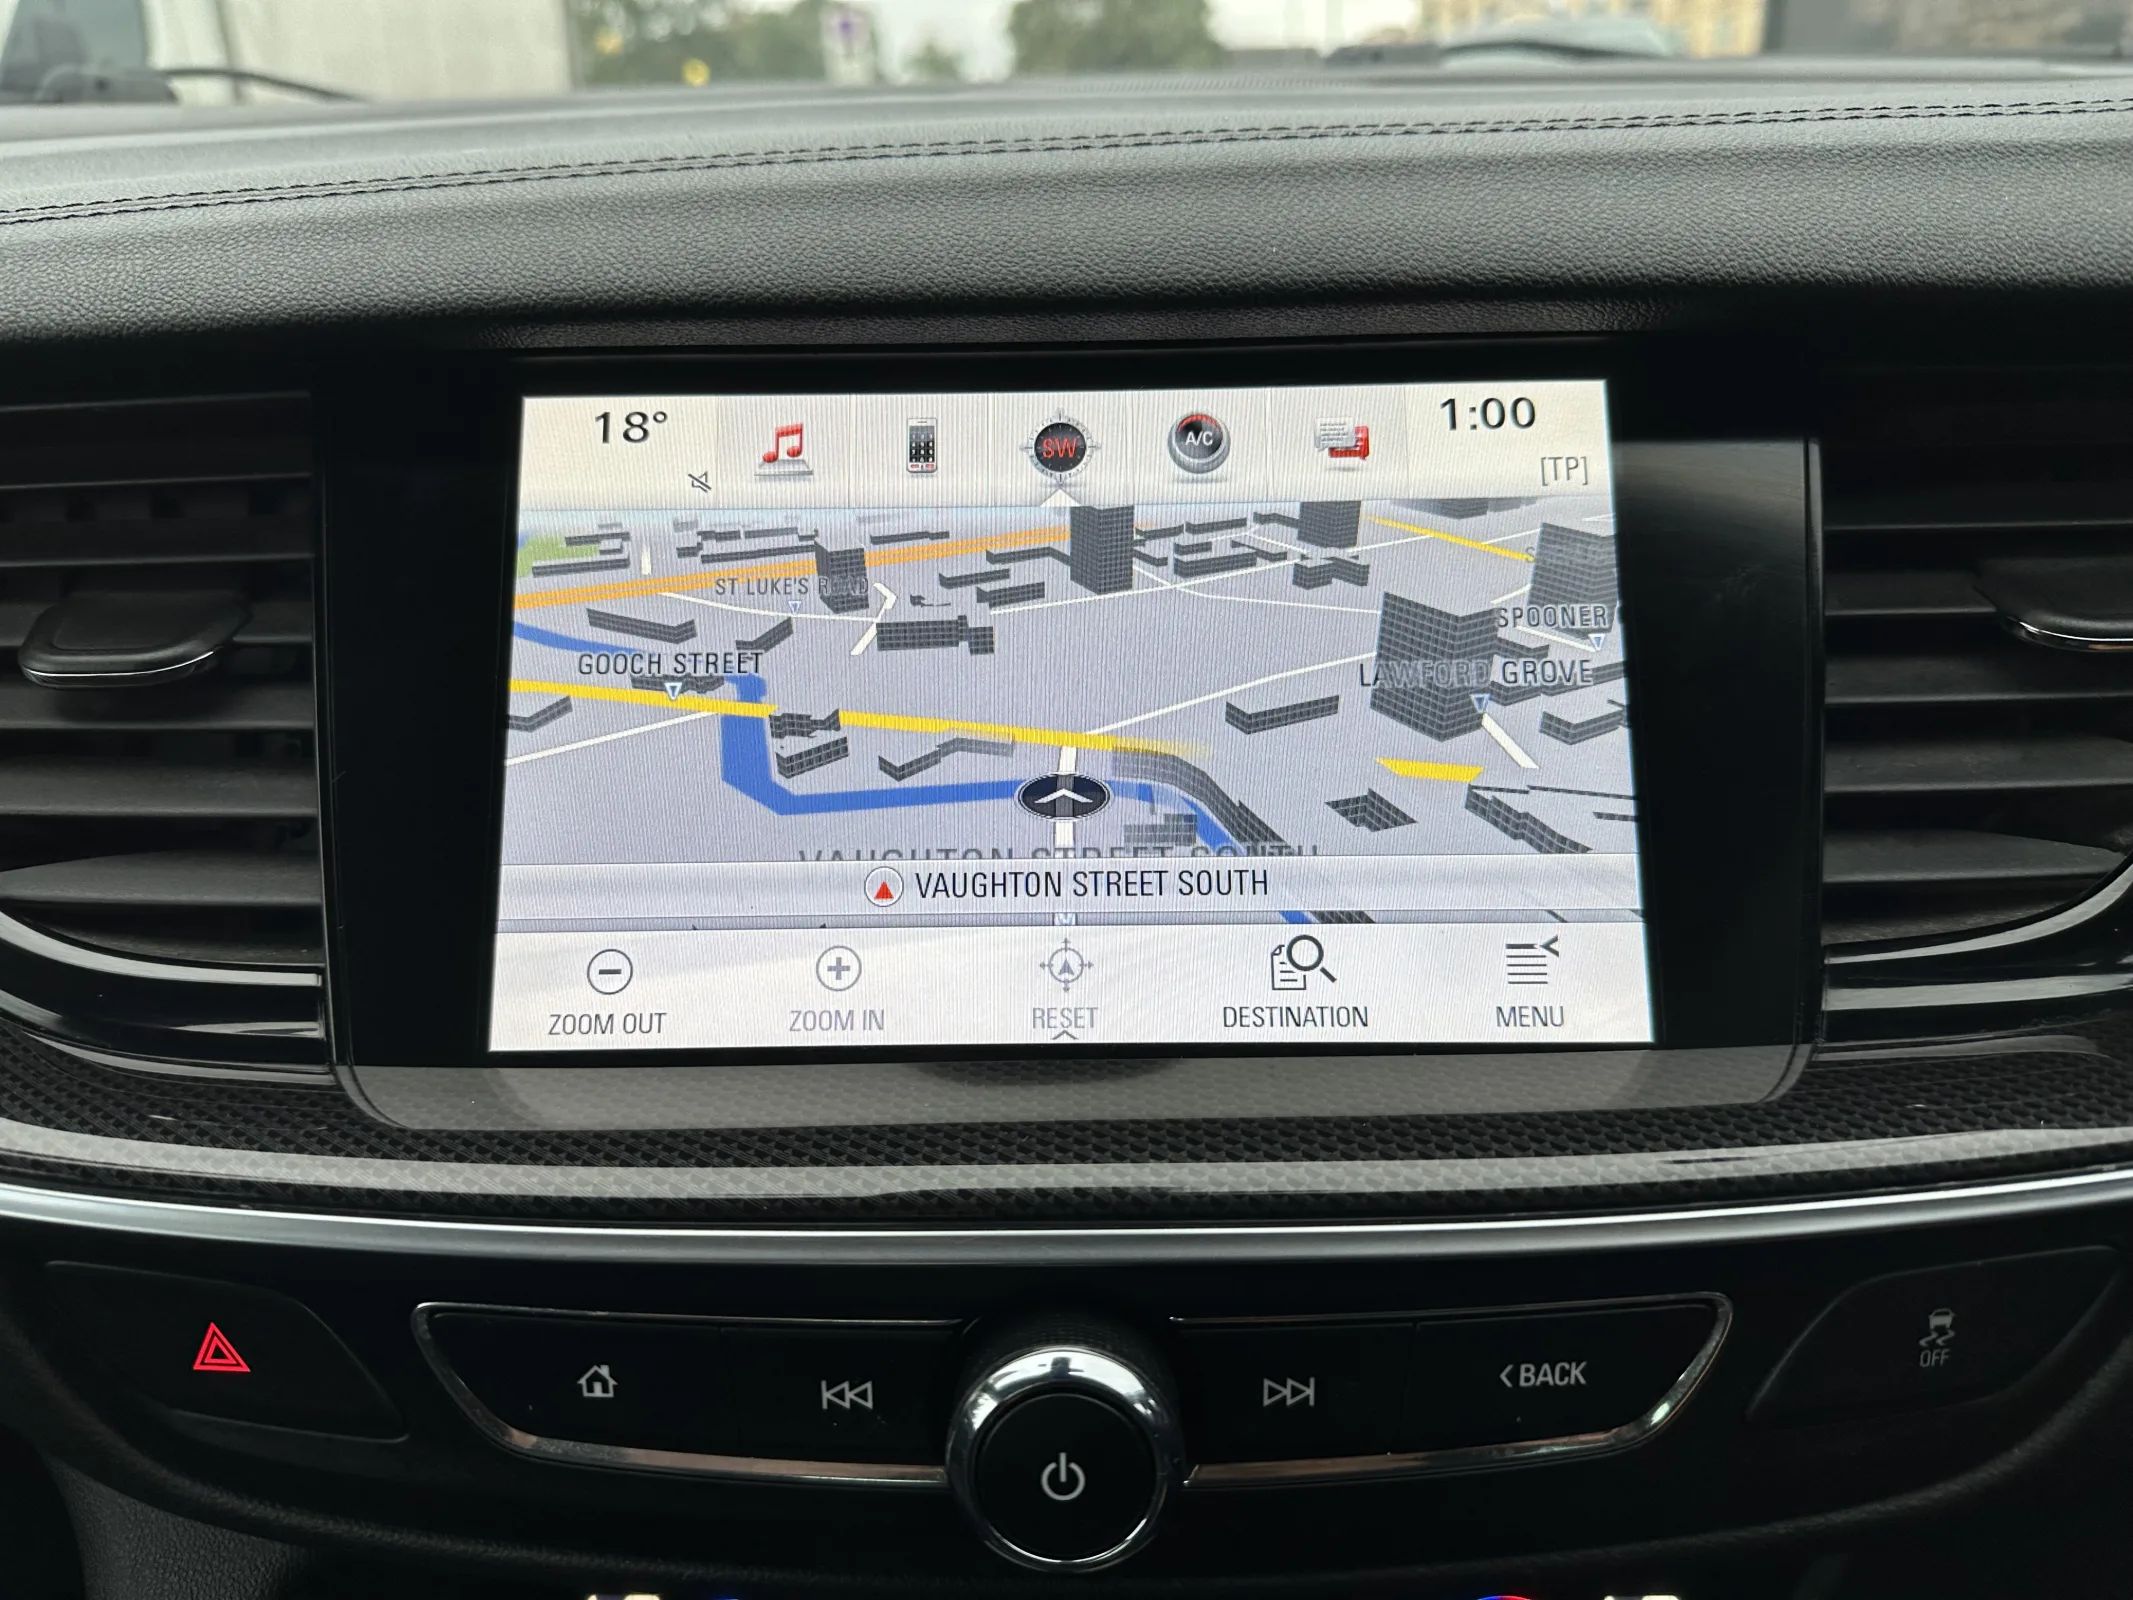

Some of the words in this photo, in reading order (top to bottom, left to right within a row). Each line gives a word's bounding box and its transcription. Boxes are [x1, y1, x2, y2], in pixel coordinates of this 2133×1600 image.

[1440, 397, 1536, 431] 1:00
[1042, 437, 1079, 459] SW
[1185, 431, 1214, 447] A/C
[715, 578, 738, 596] ST
[747, 577, 809, 596] LUKE'S
[1497, 604, 1607, 629] SPOONER
[578, 653, 662, 676] GOOCH
[673, 652, 764, 675] STREET
[1359, 659, 1490, 687] LAWFORD
[1502, 659, 1595, 684] GROVE
[915, 871, 1062, 899] VAUGHTON
[1072, 870, 1169, 897] STREET
[1178, 869, 1268, 896] SOUTH
[548, 1013, 615, 1036] ZOOM
[622, 1012, 667, 1035] OUT
[789, 1010, 857, 1033] ZOOM
[862, 1009, 885, 1032] IN
[1032, 1007, 1098, 1030] RESET
[1223, 1005, 1369, 1029] DESTINATION
[1496, 1005, 1566, 1028] MENU
[1919, 1348, 1952, 1369] OFF
